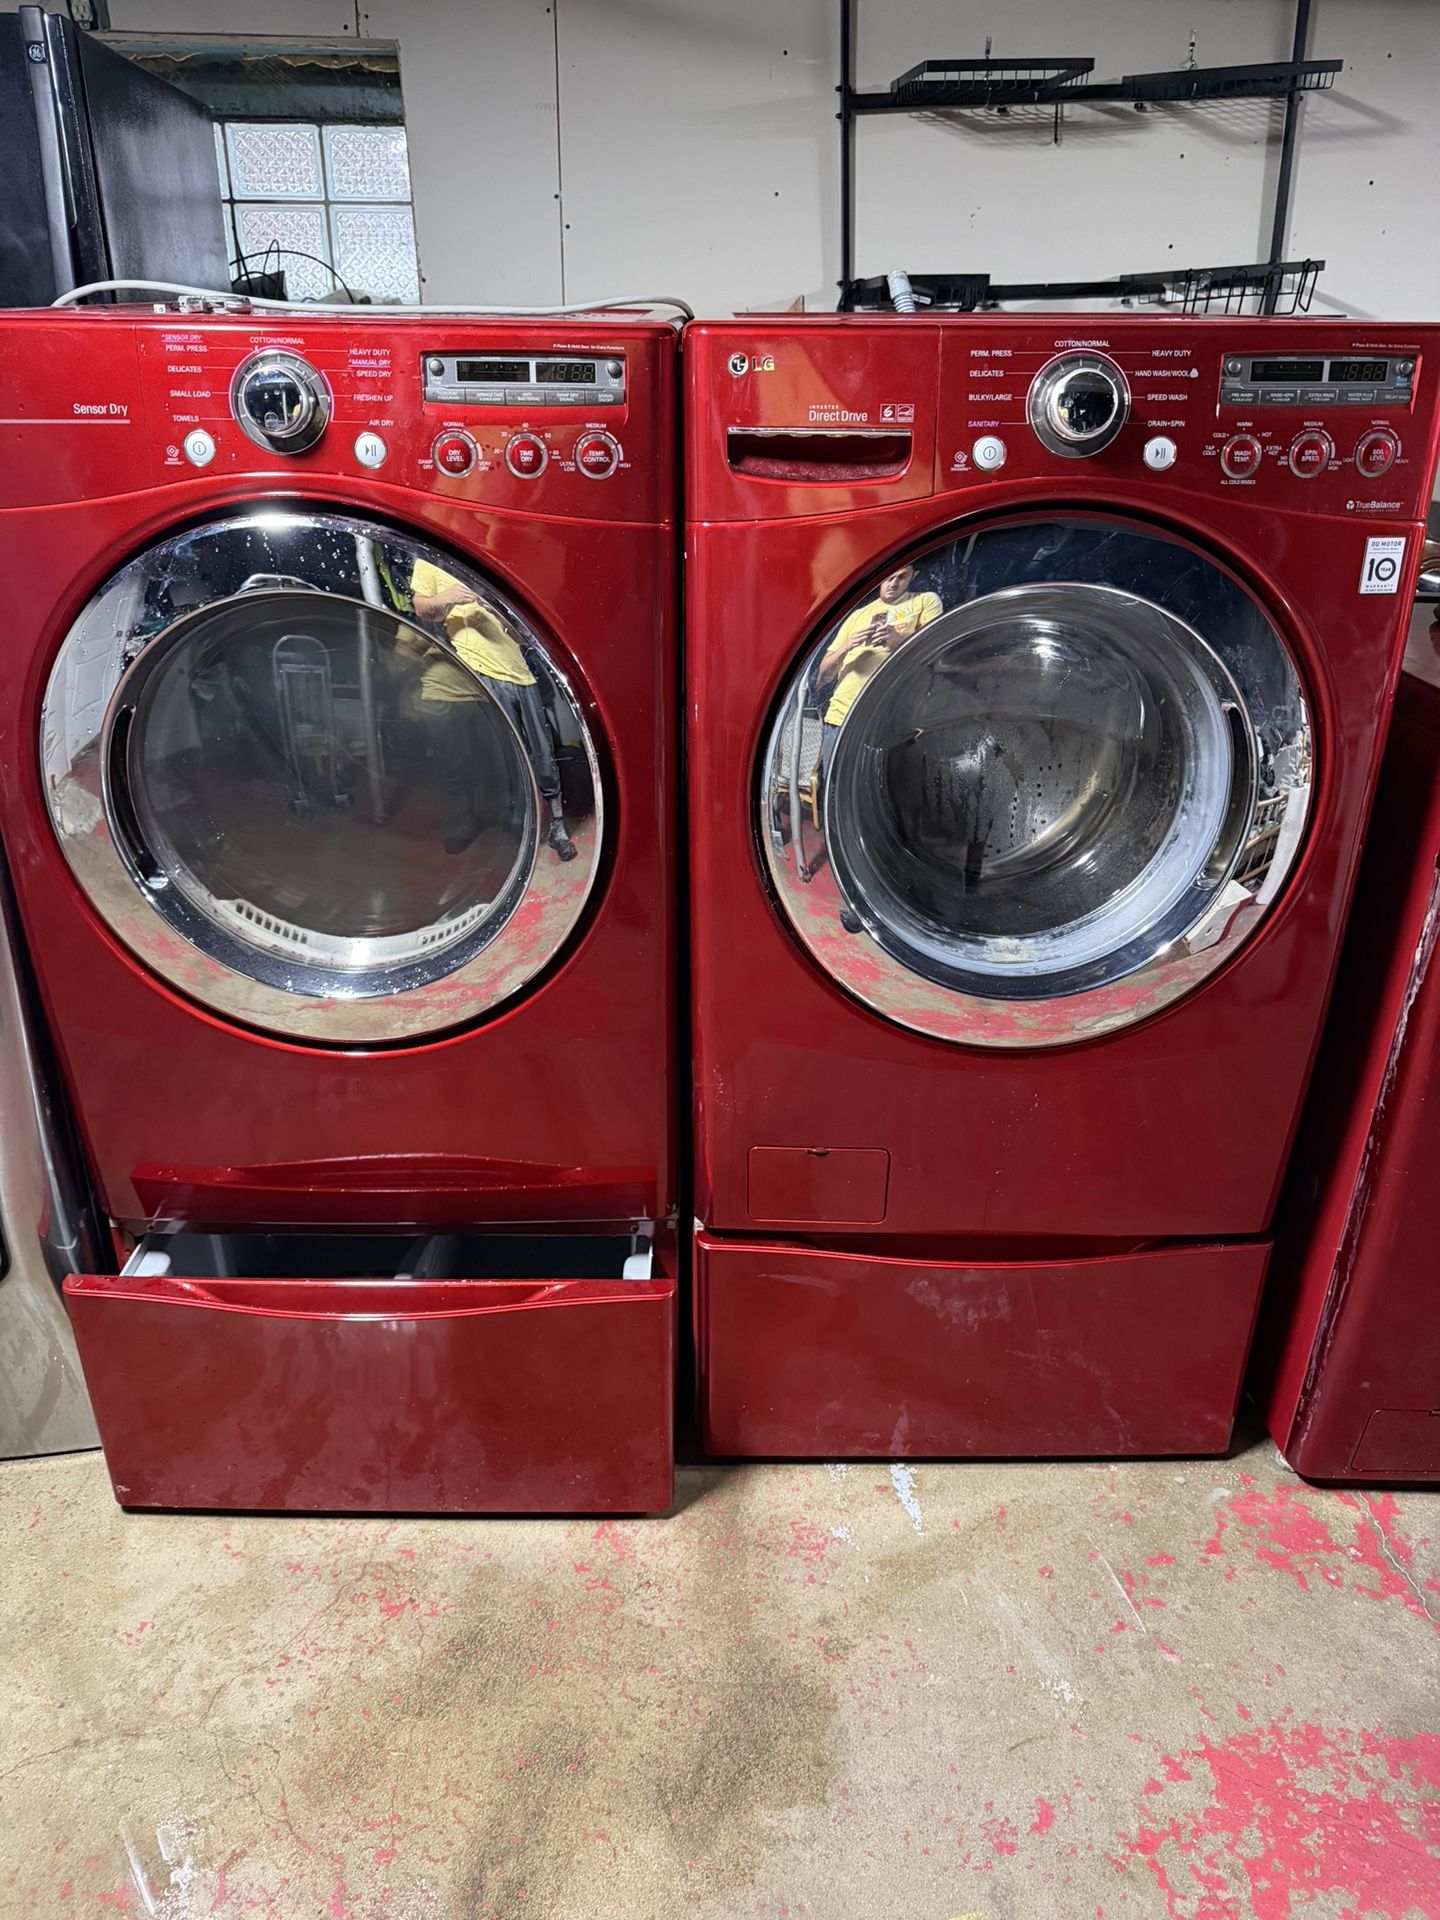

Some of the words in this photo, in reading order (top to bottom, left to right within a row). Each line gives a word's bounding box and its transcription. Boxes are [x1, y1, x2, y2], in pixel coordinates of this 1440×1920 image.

[250, 336, 304, 344] COTTON/NORMAL
[752, 356, 774, 371] LG
[73, 403, 107, 414] Sensor
[110, 403, 128, 416] Dry
[809, 410, 839, 421] Direct
[842, 410, 868, 421] Drive
[883, 406, 893, 417] 6
[1368, 558, 1396, 581] 10
